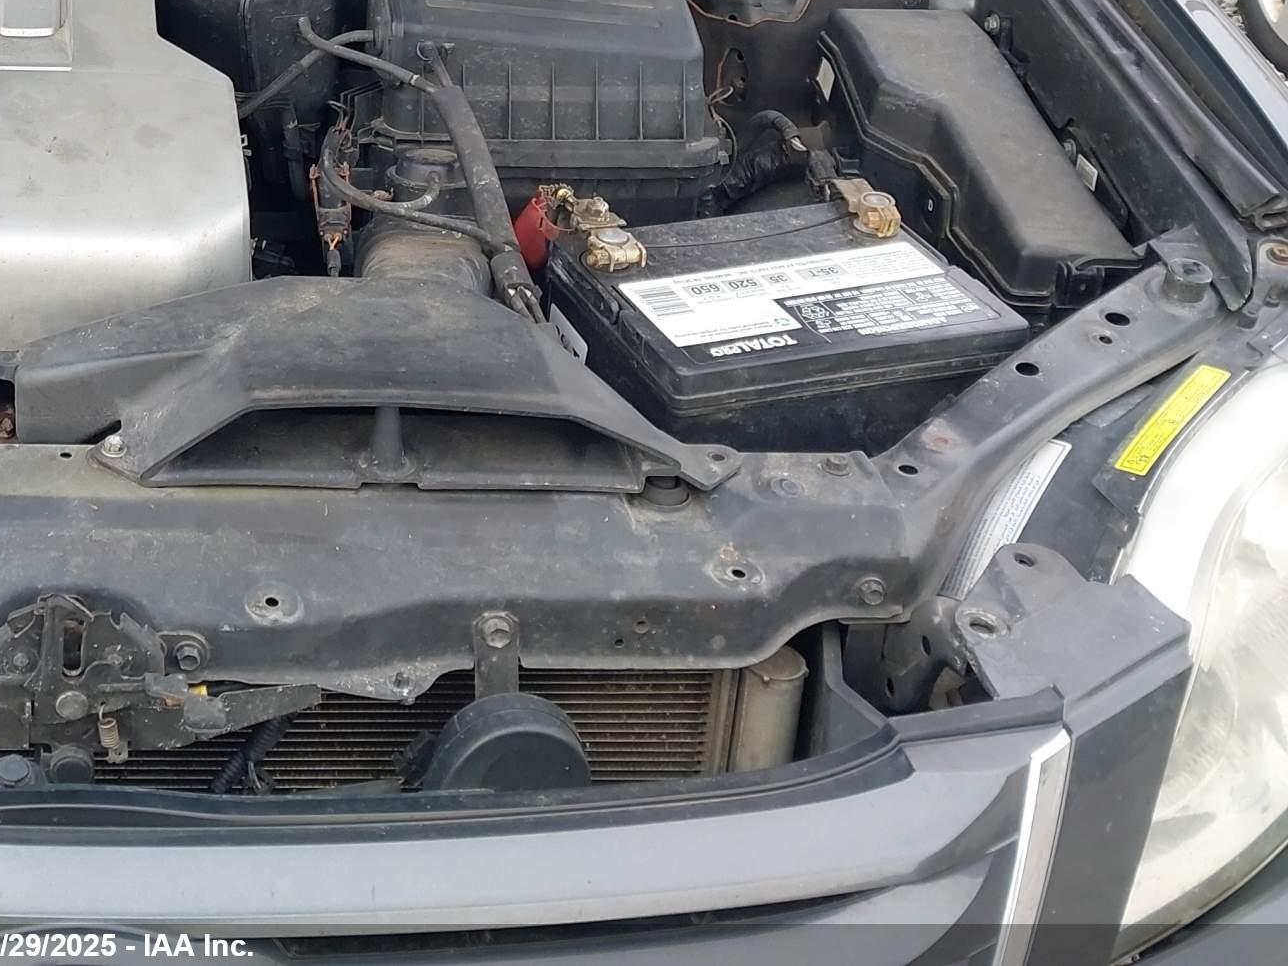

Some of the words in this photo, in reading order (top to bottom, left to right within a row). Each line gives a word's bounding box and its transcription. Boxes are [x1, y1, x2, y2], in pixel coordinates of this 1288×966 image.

[728, 278, 759, 290] 520
[768, 274, 788, 284] 35
[690, 283, 721, 295] 650
[709, 334, 799, 357] TOTALPRO
